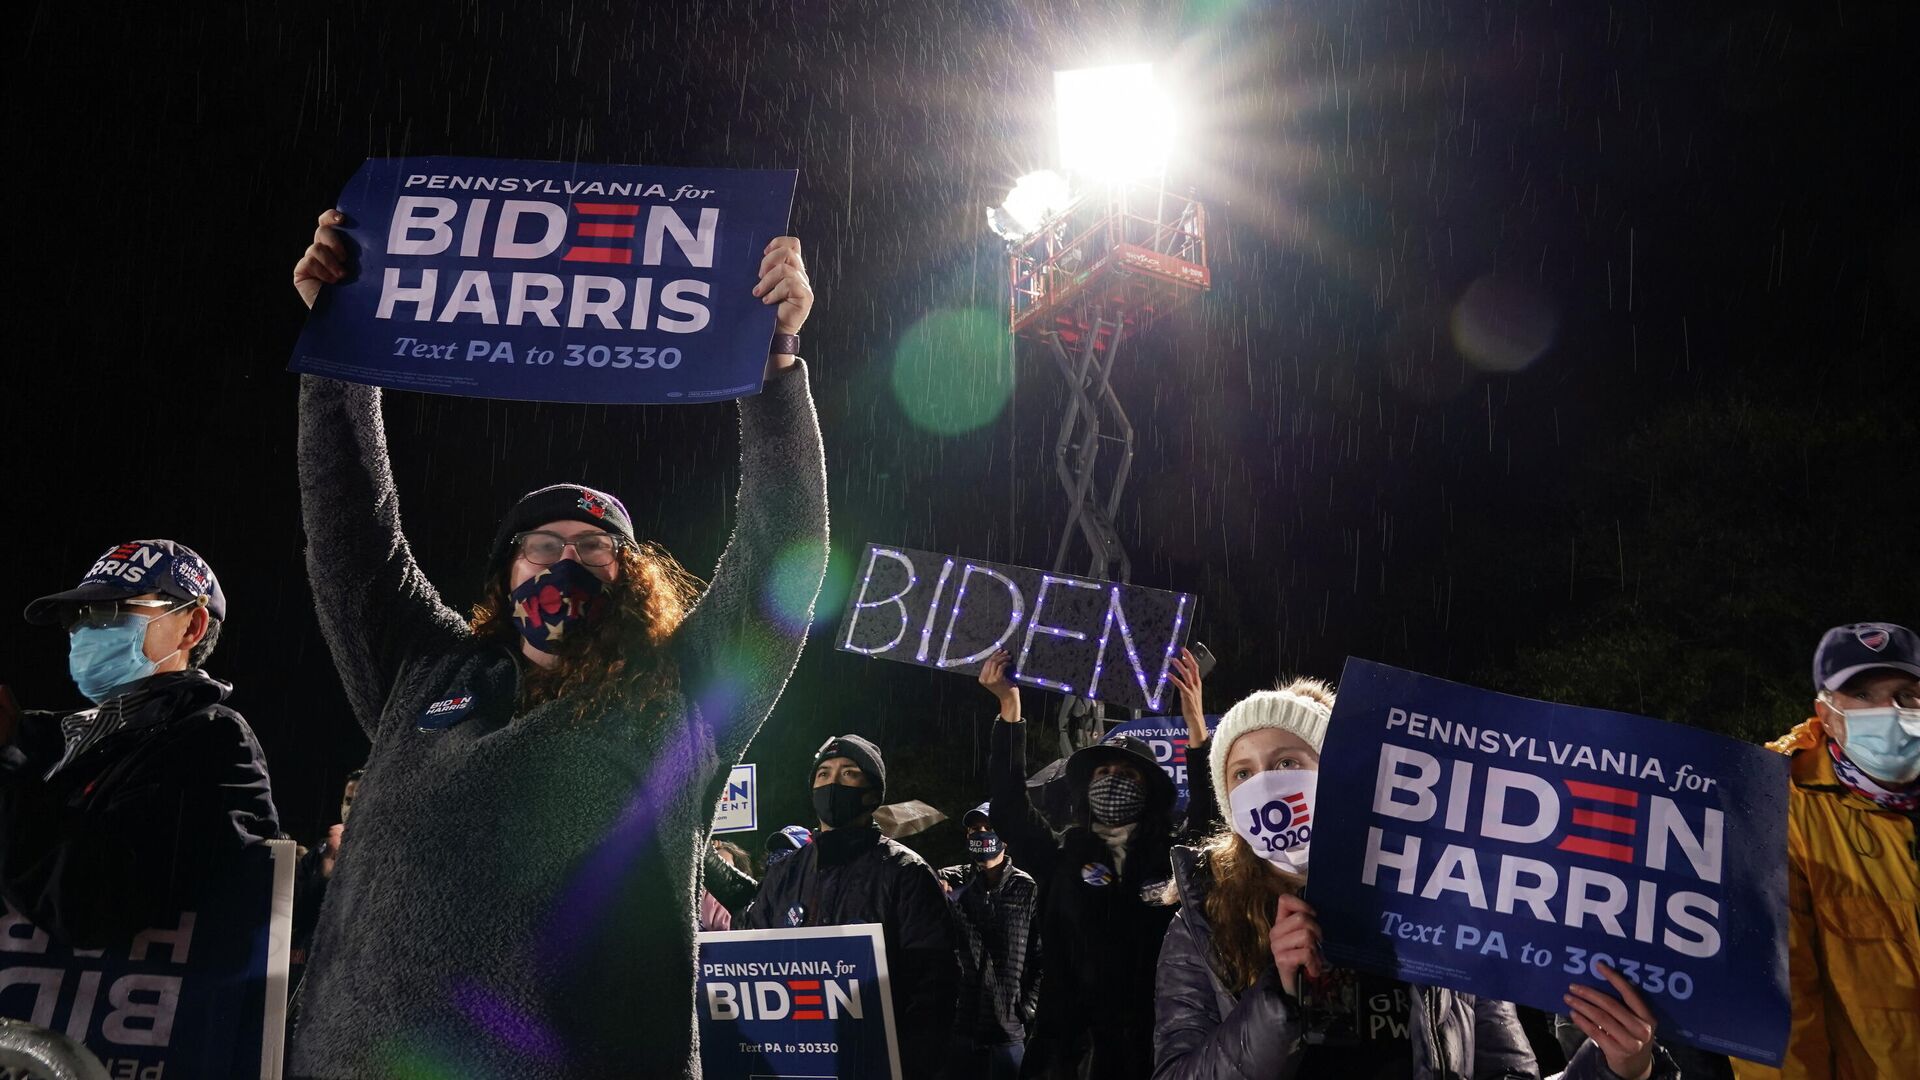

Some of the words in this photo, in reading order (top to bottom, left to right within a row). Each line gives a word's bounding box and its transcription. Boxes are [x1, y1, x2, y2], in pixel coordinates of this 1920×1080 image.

[404, 175, 666, 198] PENNSYLVANIA
[669, 183, 715, 201] for
[387, 195, 720, 268] BIDEN
[375, 267, 712, 334] HARRIS
[393, 337, 459, 362] Text
[465, 341, 515, 364] PA
[525, 347, 555, 366] to
[564, 344, 682, 370] 30330
[845, 548, 1187, 711] BIDEN
[426, 703, 467, 715] HARRIS
[430, 696, 472, 709] BIDEN
[1386, 707, 1665, 783] PENNSYLVANIA
[1668, 764, 1717, 793] for
[1249, 792, 1310, 835] JOE
[1371, 742, 1724, 885] BIDEN
[970, 839, 996, 847] BIDEN
[1262, 825, 1311, 852] 2020
[1361, 826, 1722, 958] HARRIS
[704, 961, 832, 977] PENNSYLVANIA
[834, 960, 856, 978] for
[1380, 911, 1447, 946] Text
[1455, 925, 1508, 960] PA
[1520, 941, 1552, 968] to
[1563, 945, 1694, 1000] 30330
[706, 978, 863, 1020] BIDEN
[739, 1042, 762, 1053] Text
[765, 1043, 782, 1053] PA
[785, 1043, 796, 1053] to
[798, 1043, 839, 1053] 30330
